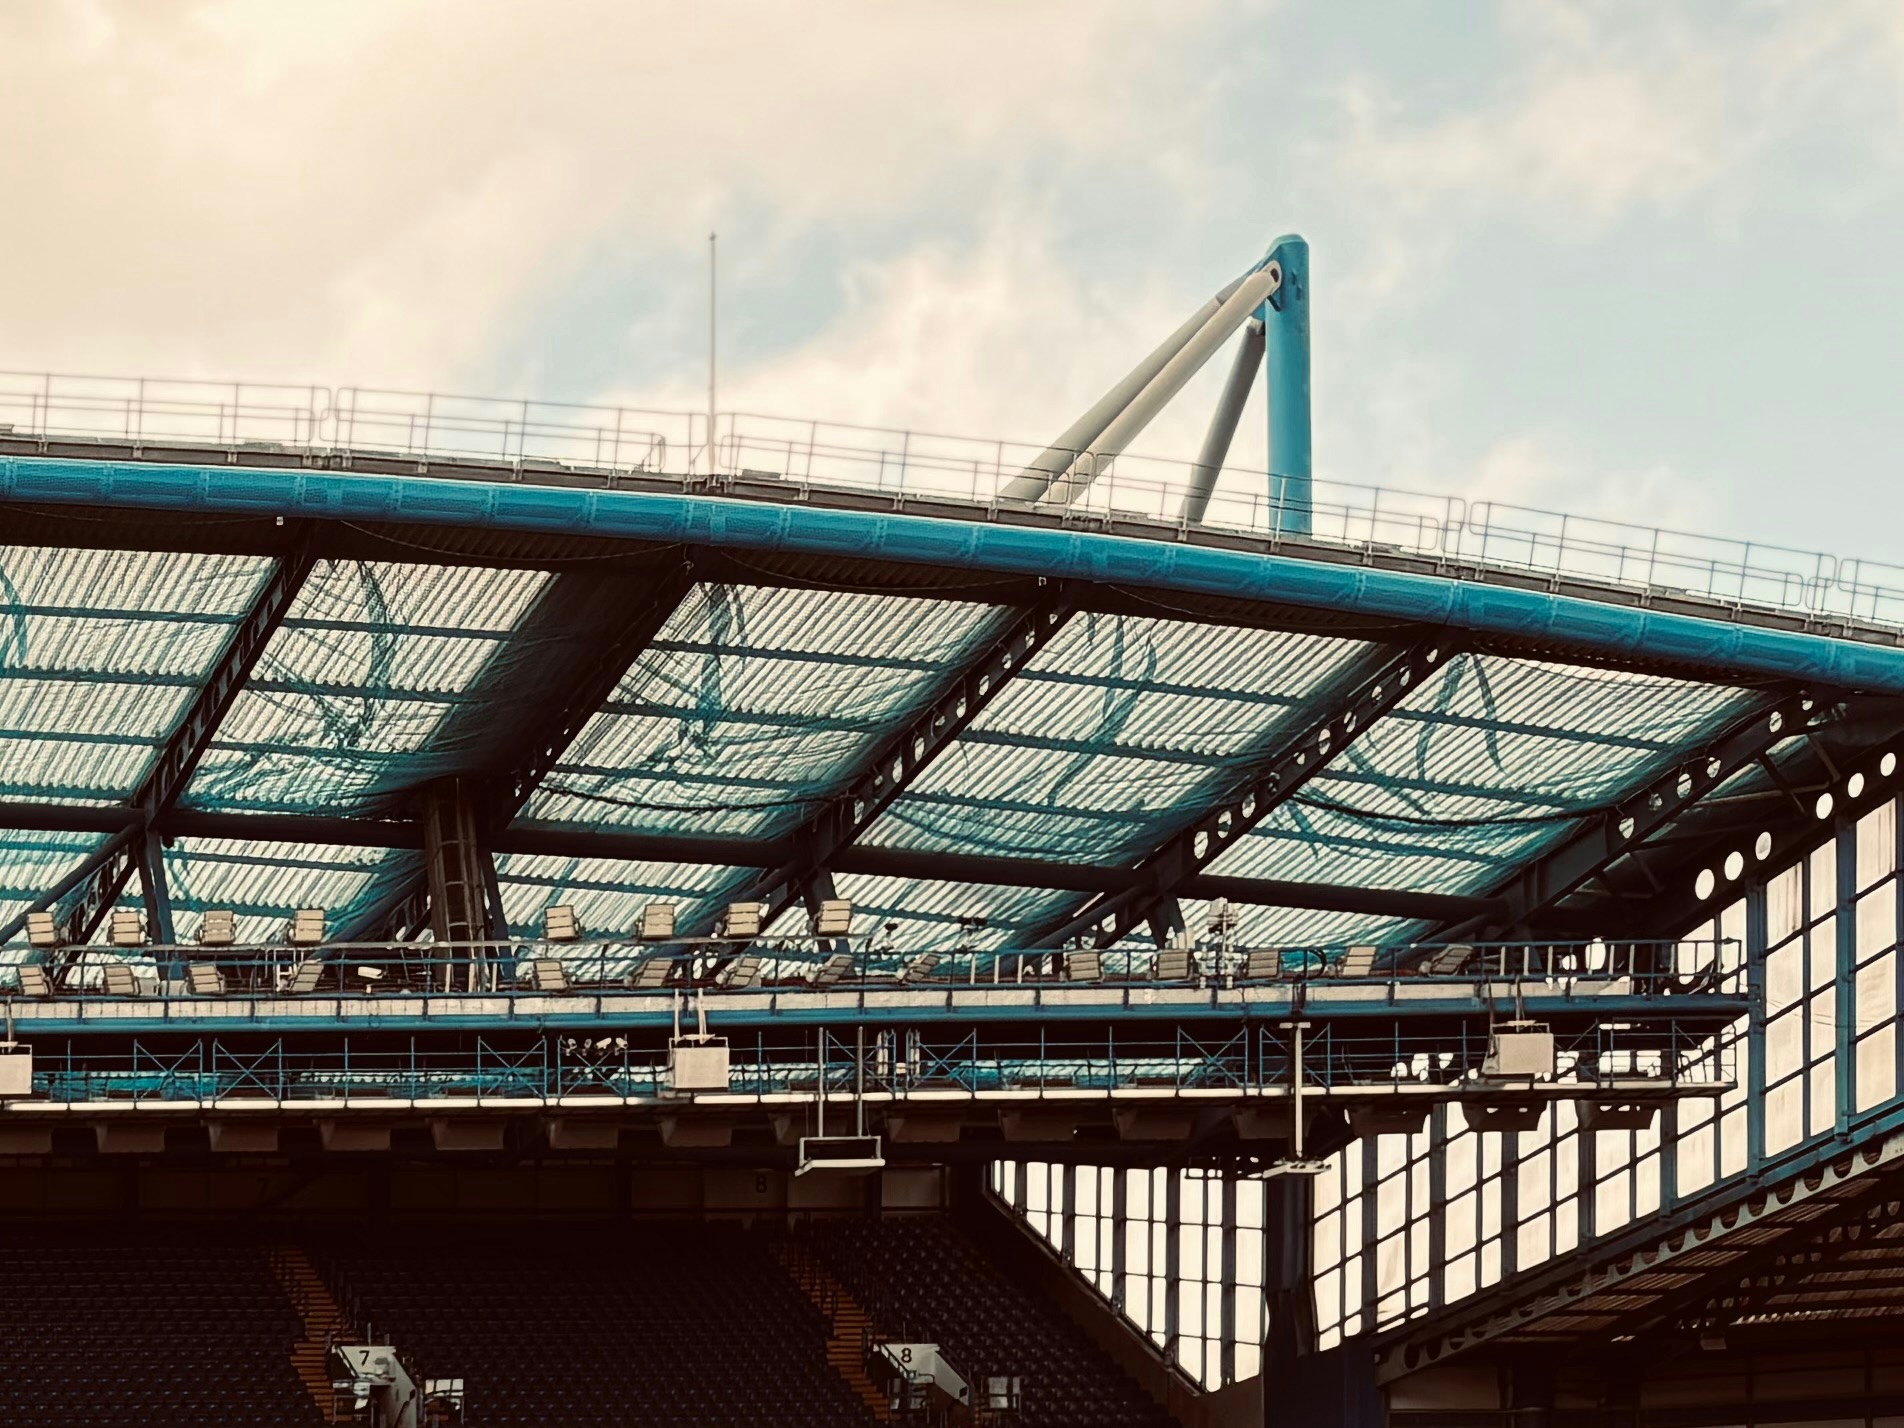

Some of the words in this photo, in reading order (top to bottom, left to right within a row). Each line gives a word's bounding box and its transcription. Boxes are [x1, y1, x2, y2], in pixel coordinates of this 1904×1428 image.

[256, 1177, 269, 1197] 7
[755, 1174, 767, 1193] 8
[359, 1350, 370, 1366] 7
[900, 1347, 912, 1363] 8
